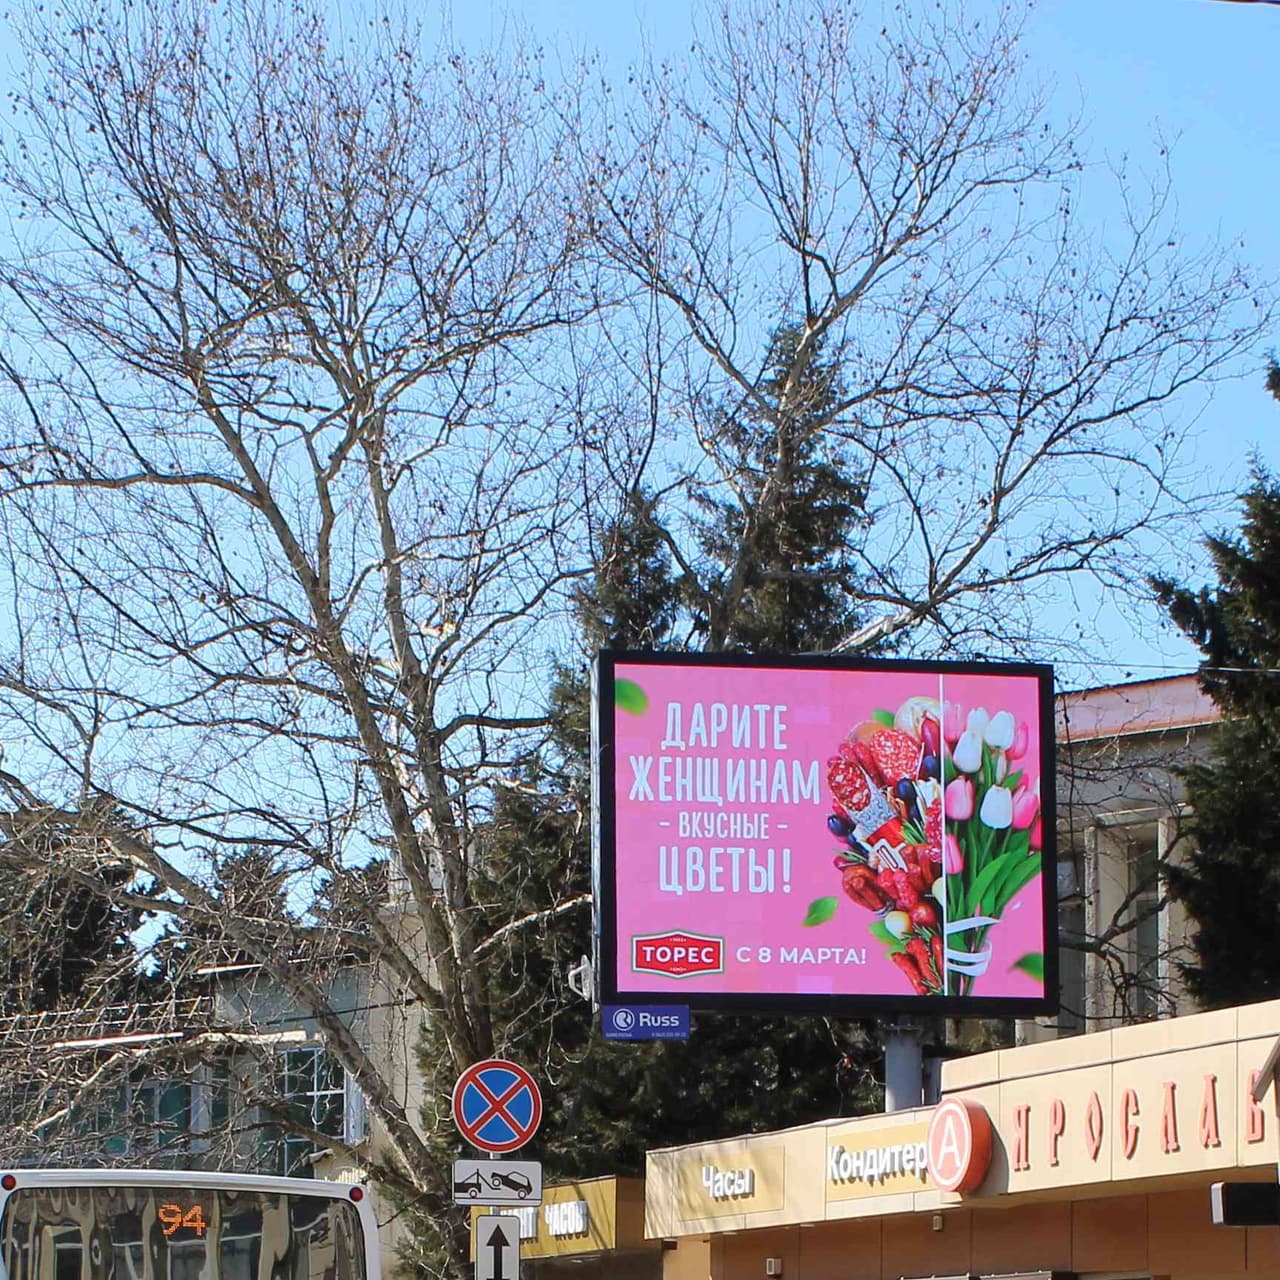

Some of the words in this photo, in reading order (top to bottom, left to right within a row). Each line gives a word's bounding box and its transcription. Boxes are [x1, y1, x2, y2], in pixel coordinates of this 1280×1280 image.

[660, 702, 788, 750] ДАРИТЕ
[628, 755, 821, 806] ЖЕНЩИНАМ
[678, 811, 770, 840] ВКУСНЫЕ
[659, 846, 791, 895] ЦВЕТЫ!
[641, 945, 715, 963] ТОРЕС
[736, 946, 752, 963] С
[758, 947, 772, 963] 8
[780, 947, 867, 965] МАРТА!
[639, 1012, 680, 1027] Russ
[702, 1165, 754, 1198] Часы
[158, 1203, 207, 1236] 94
